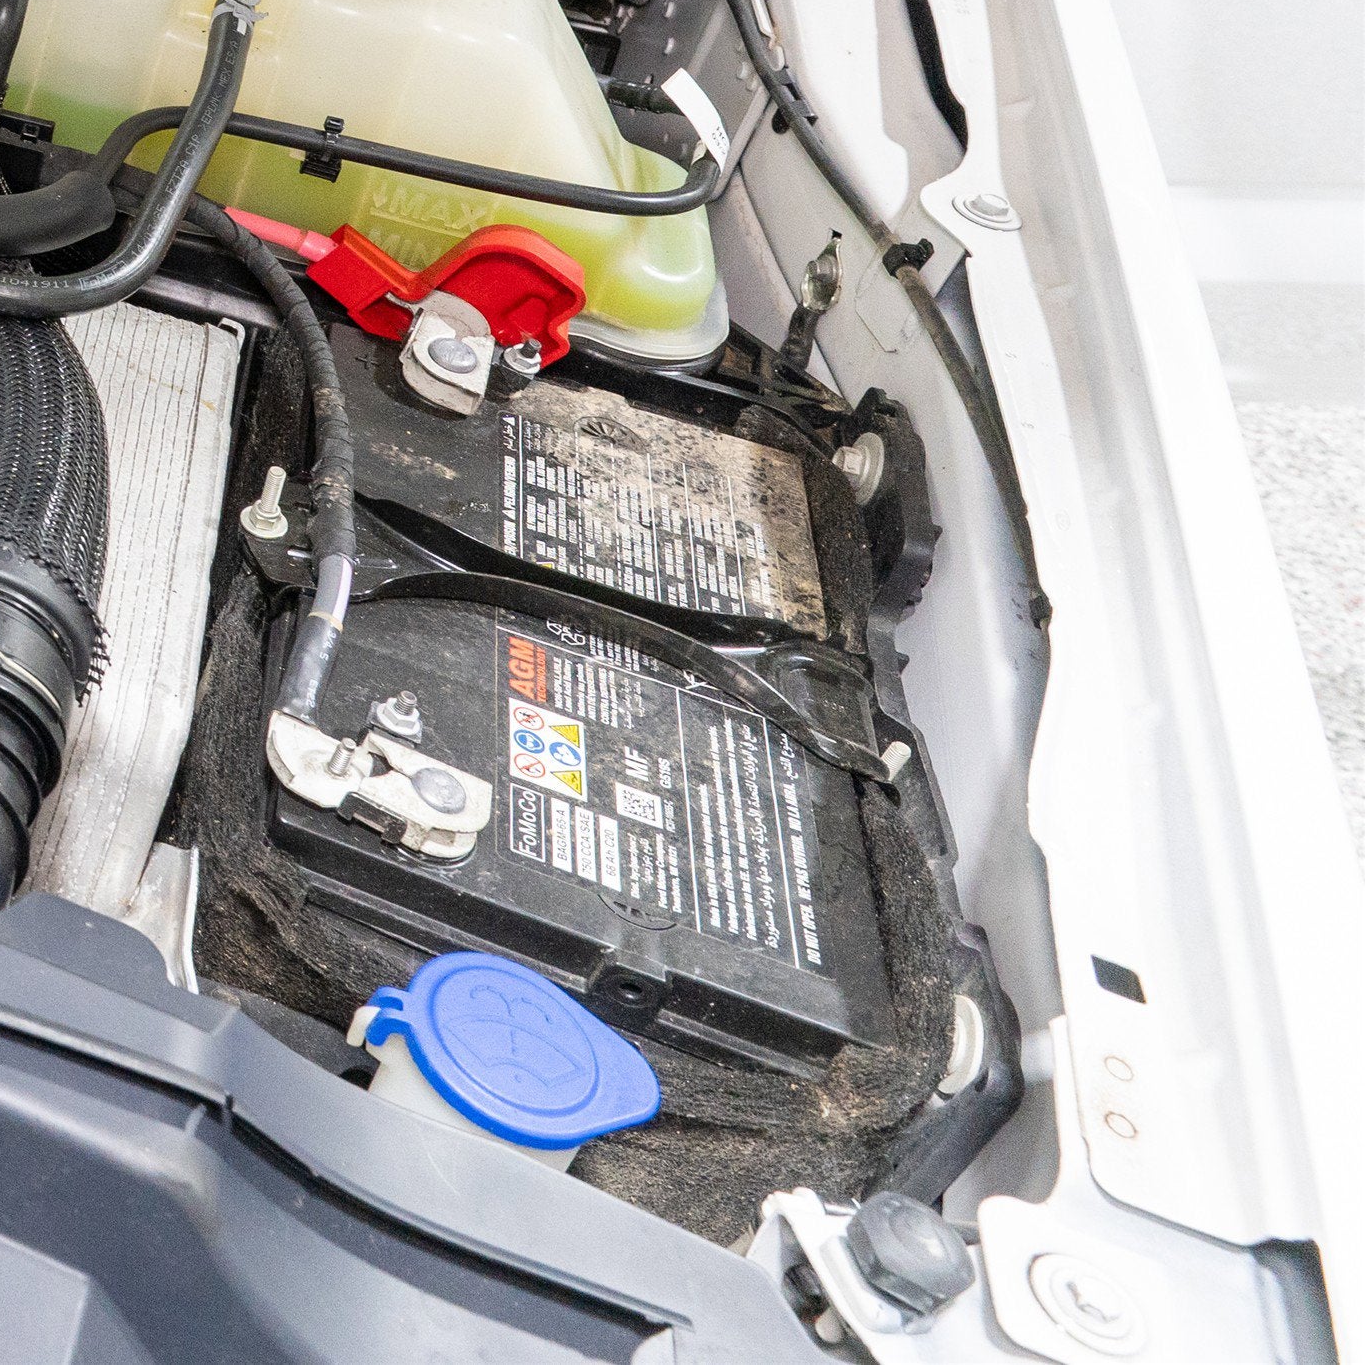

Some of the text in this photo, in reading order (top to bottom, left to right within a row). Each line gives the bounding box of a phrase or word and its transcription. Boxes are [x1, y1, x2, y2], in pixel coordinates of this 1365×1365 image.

[389, 184, 486, 232] MAX
[508, 637, 536, 699] AGM
[536, 649, 546, 701] TECHNOLOGY
[624, 746, 649, 782] MF
[514, 785, 537, 857] FoMoCo
[786, 806, 800, 819] LA
[788, 817, 802, 832] NO
[556, 810, 567, 861] BAGM-65-A
[604, 829, 615, 848] C20
[791, 835, 807, 869] OUVRIR.
[582, 858, 592, 872] 750
[795, 868, 810, 887] PAS
[797, 885, 811, 901] NE
[800, 904, 816, 930] OPEN.
[803, 928, 819, 950] NOT
[806, 948, 821, 965] DO
